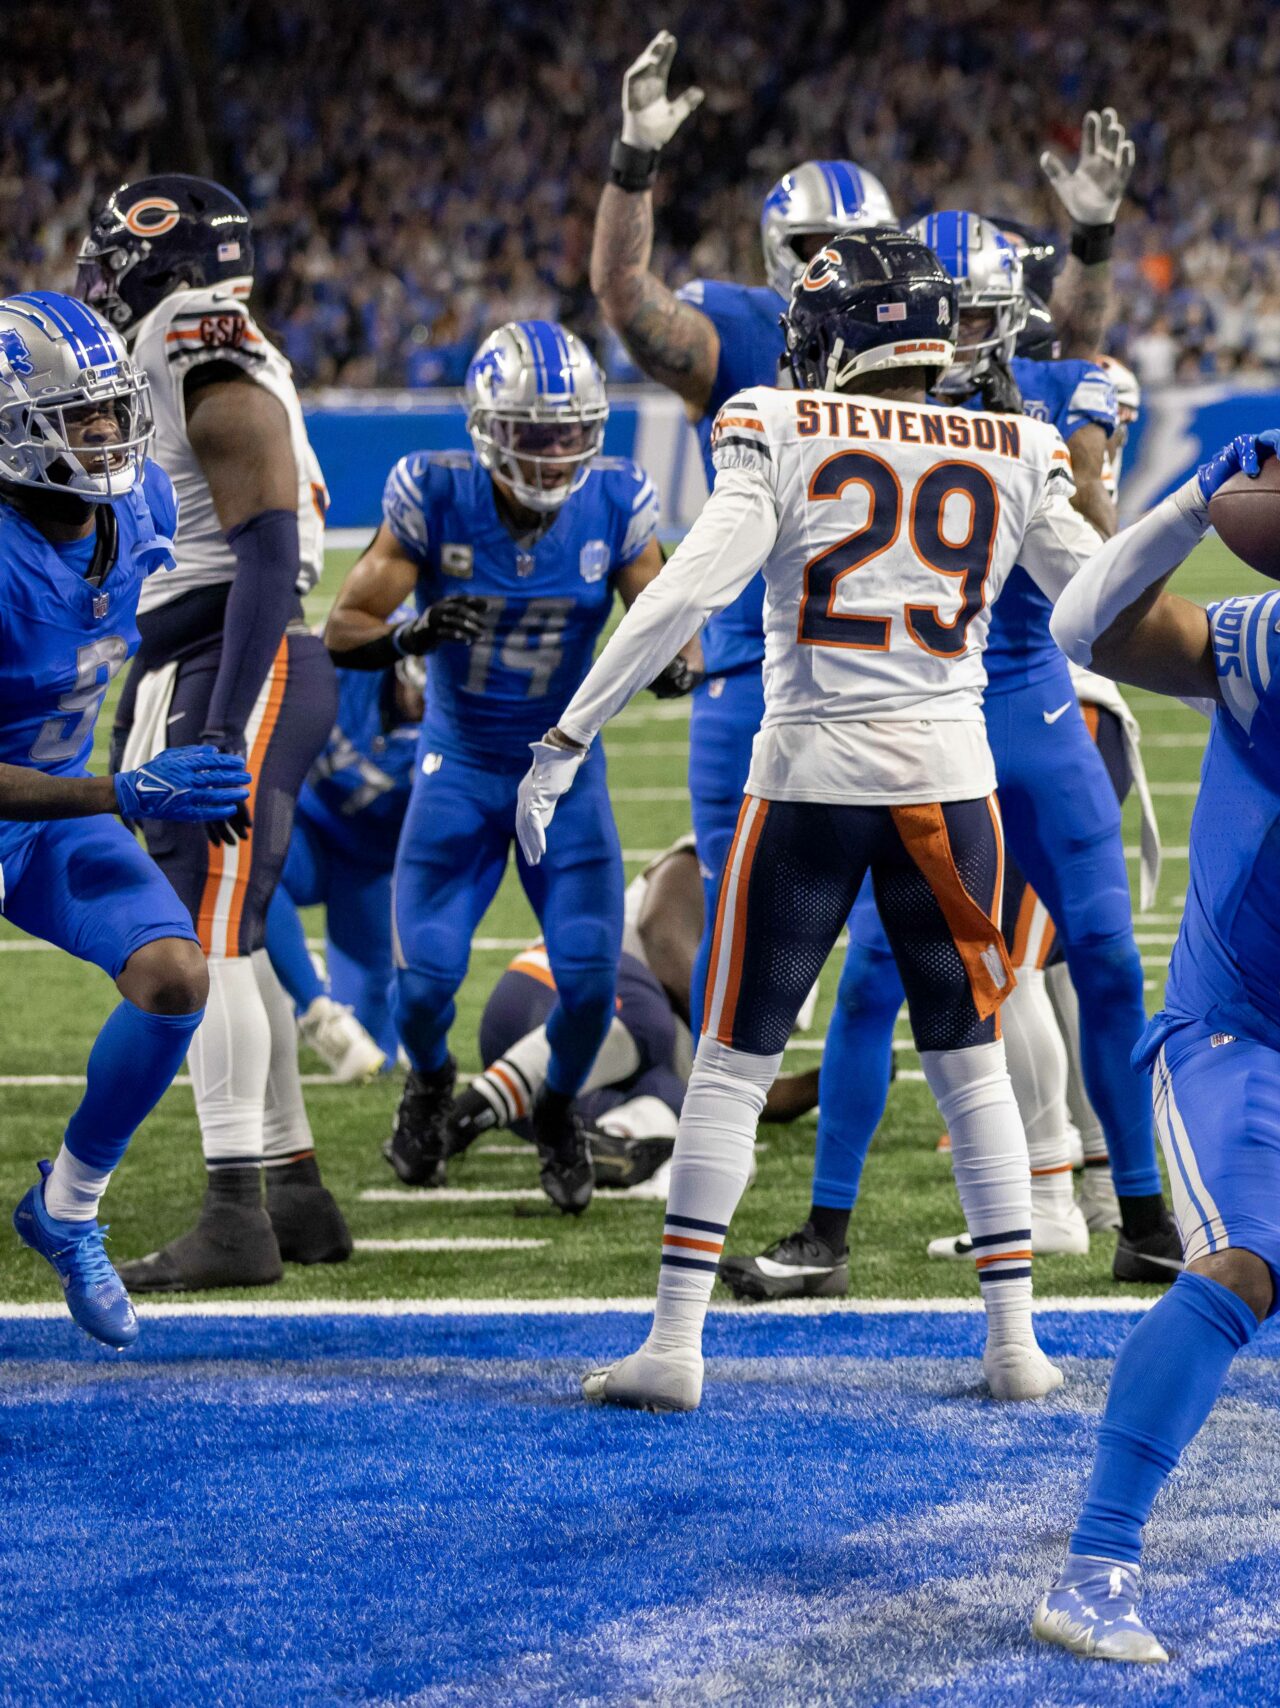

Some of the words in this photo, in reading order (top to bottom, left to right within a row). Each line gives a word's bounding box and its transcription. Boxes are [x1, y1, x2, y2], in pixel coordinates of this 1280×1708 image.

[894, 342, 946, 356] BEARS
[796, 399, 1020, 459] STEVENSON
[797, 448, 1001, 659] 29
[465, 596, 577, 698] 14
